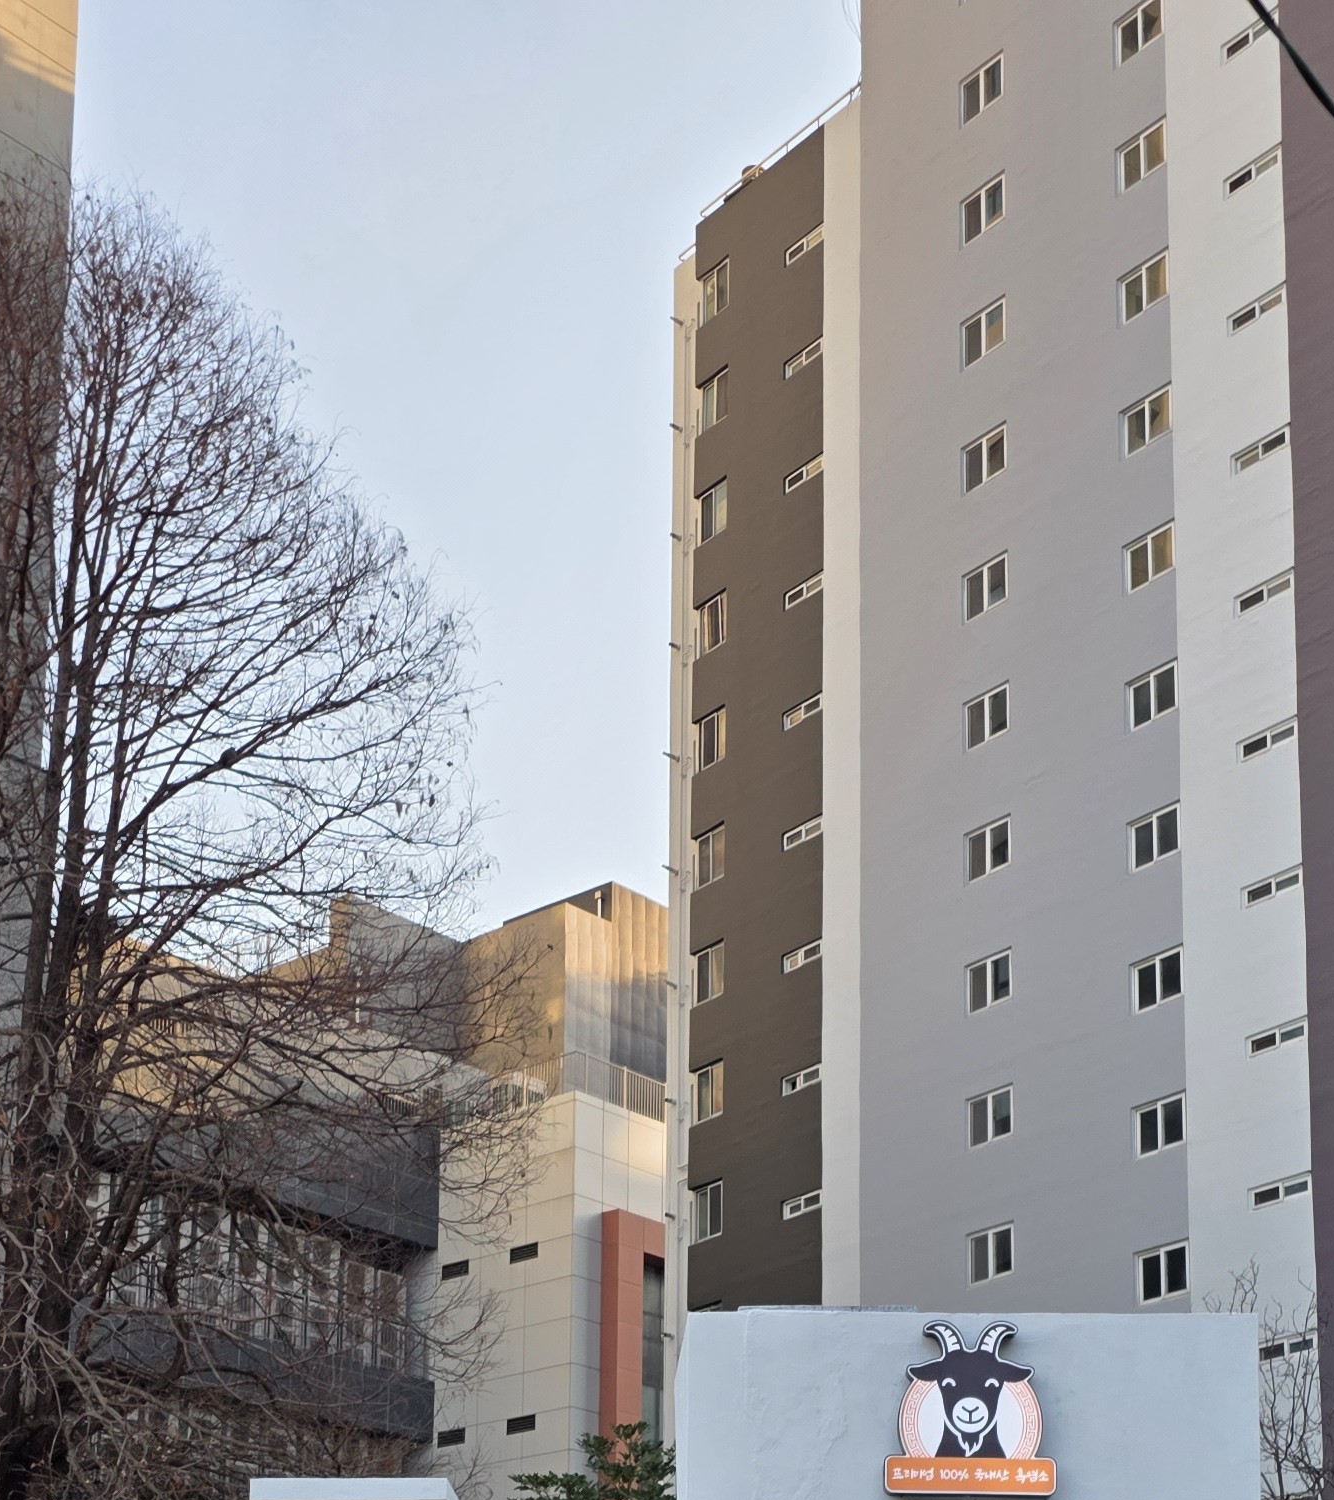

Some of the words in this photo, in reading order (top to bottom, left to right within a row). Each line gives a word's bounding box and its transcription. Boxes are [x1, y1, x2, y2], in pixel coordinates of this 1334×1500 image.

[892, 1468, 934, 1481] 프리미엄
[940, 1469, 969, 1481] 100%
[975, 1468, 1009, 1481] 국내산
[1015, 1468, 1049, 1483] 흑염소
